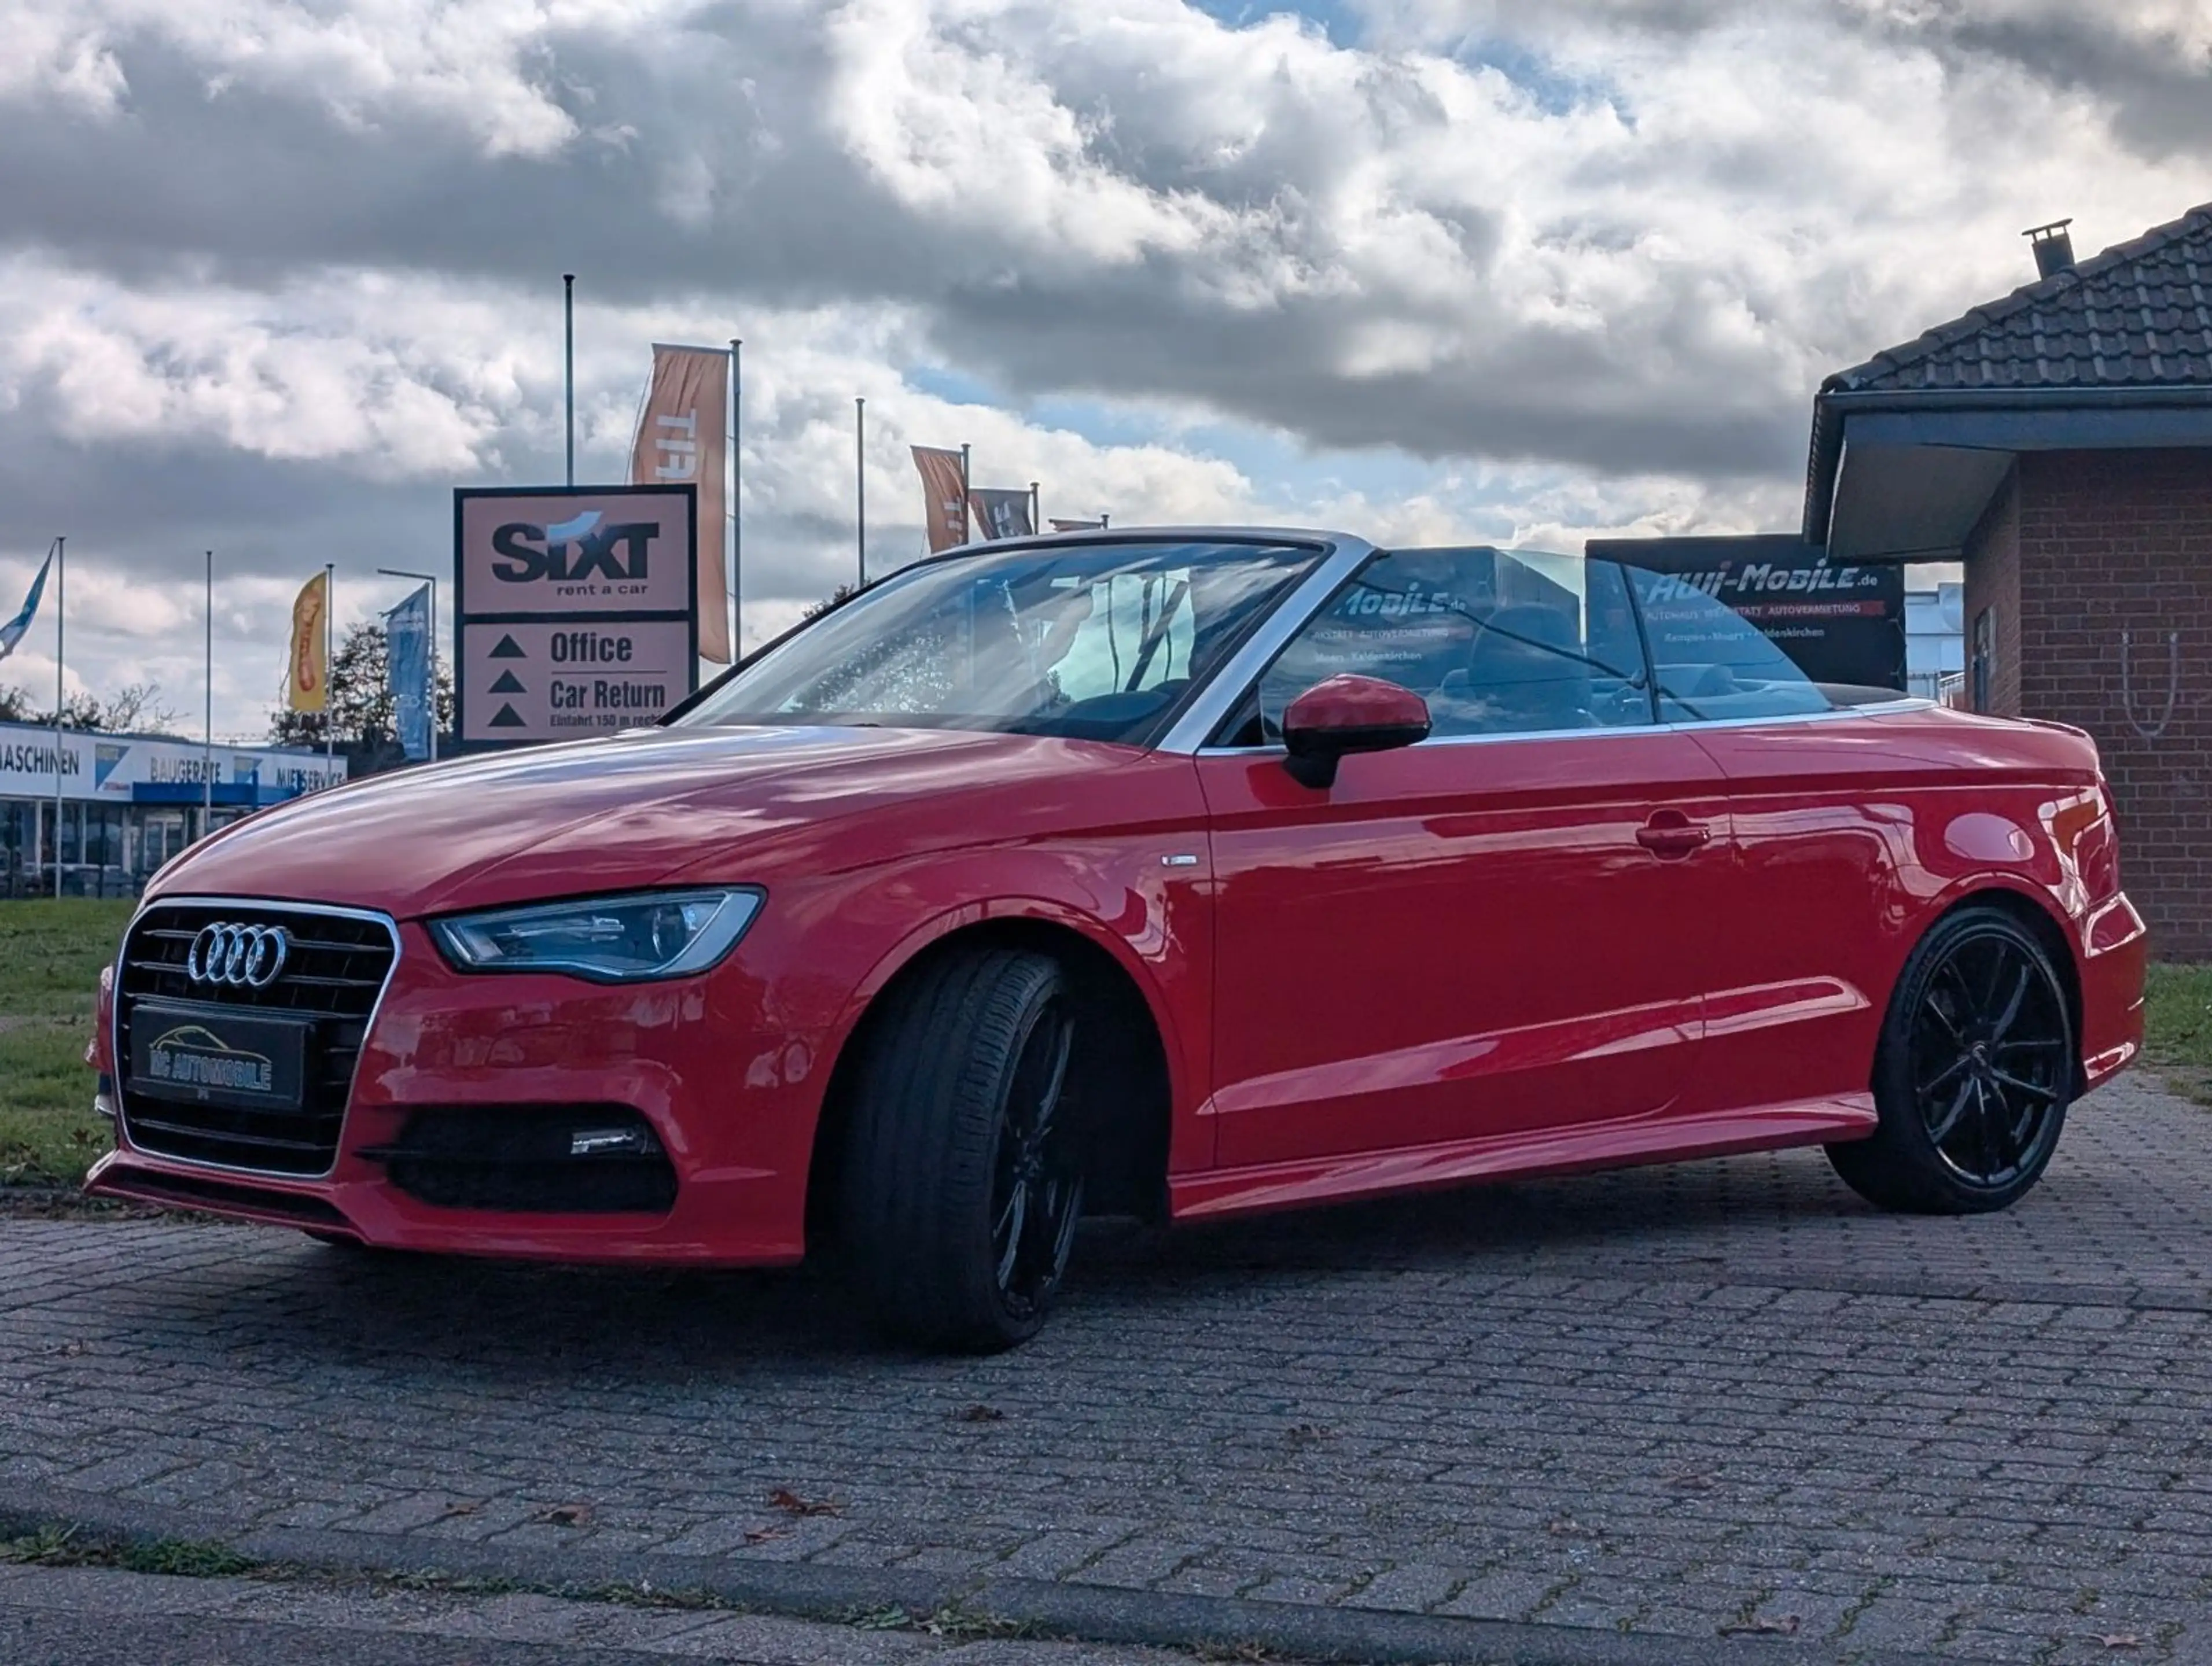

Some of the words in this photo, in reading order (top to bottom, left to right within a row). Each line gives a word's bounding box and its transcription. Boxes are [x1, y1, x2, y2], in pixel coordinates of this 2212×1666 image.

[557, 584, 595, 596] rent
[601, 585, 612, 595] a
[618, 585, 648, 595] car
[550, 632, 632, 662] Office
[550, 680, 587, 709] Car
[594, 680, 665, 708] Return
[550, 714, 592, 727] Einfahrt
[597, 714, 616, 727] 150
[0, 744, 79, 775] ASCHINEN
